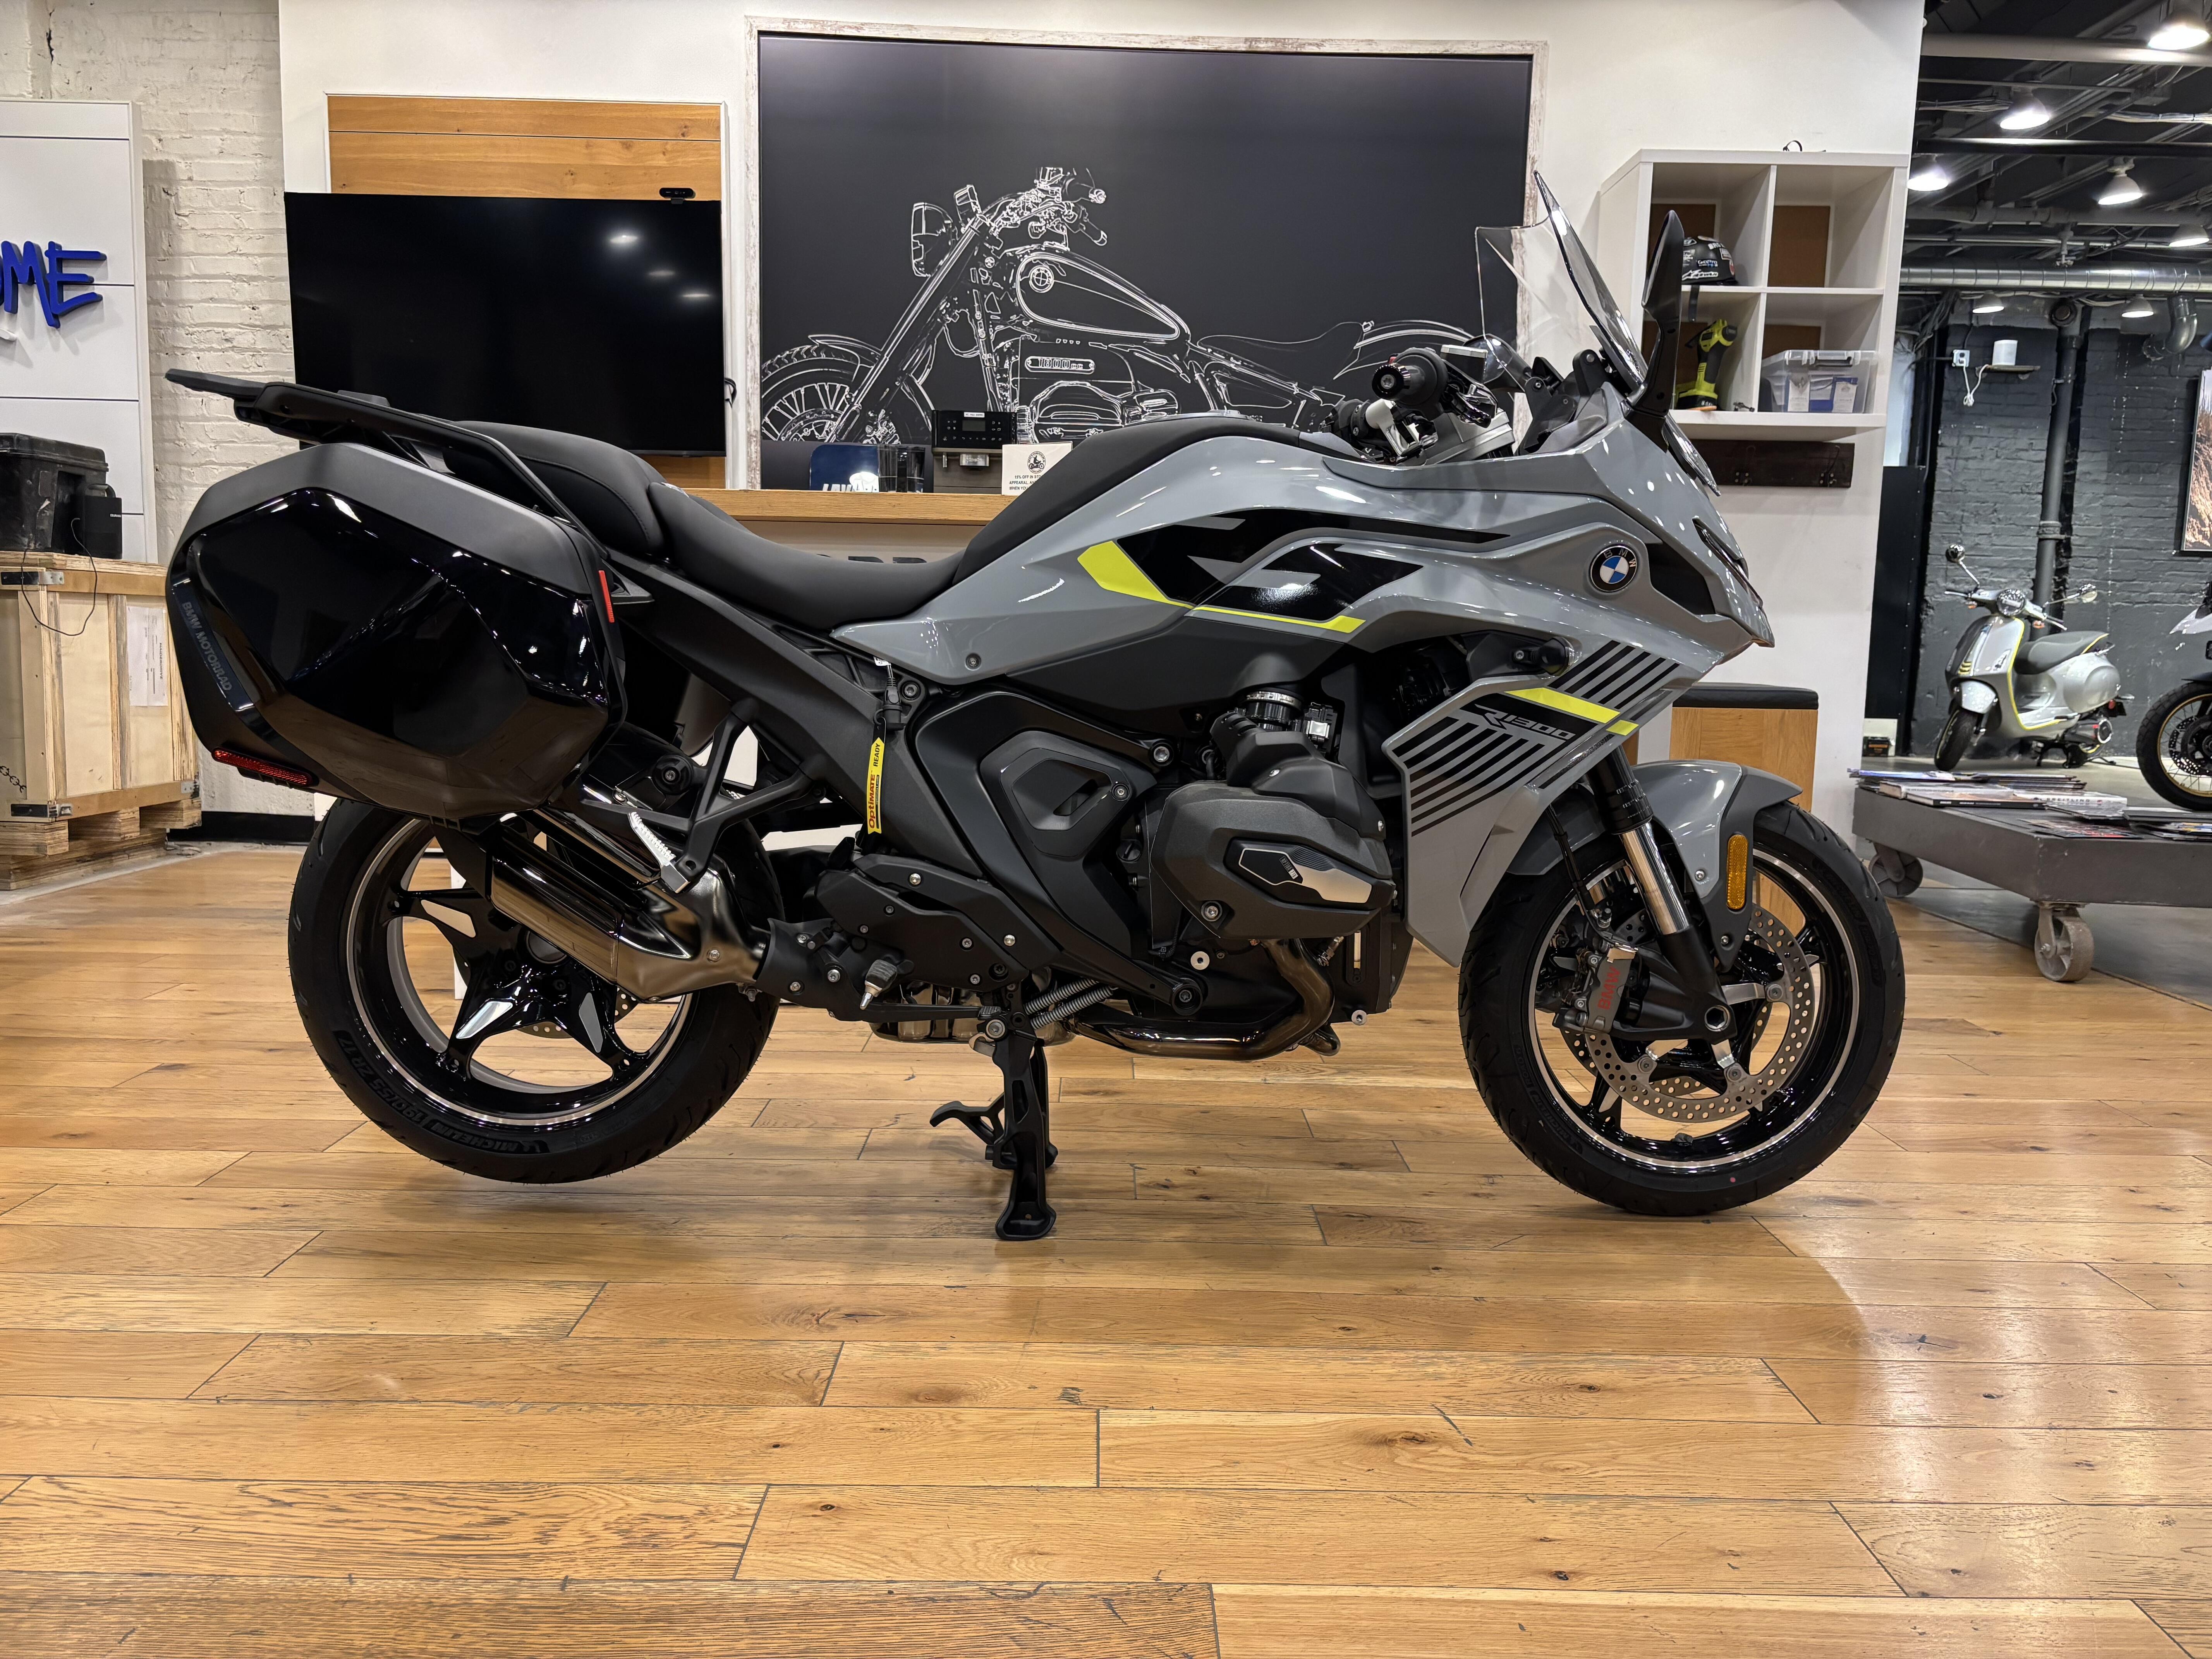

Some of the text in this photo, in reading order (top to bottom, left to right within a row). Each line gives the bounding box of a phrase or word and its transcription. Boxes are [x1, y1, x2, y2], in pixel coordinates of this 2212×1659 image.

[0, 240, 107, 328] ME
[1038, 358, 1083, 369] 1800cc
[1603, 548, 1636, 567] BMW
[182, 601, 232, 691] BMW MOTORRAD
[1597, 966, 1621, 1010] BMW
[337, 1033, 518, 1154] MICHELIN 190/55 ZR 17
